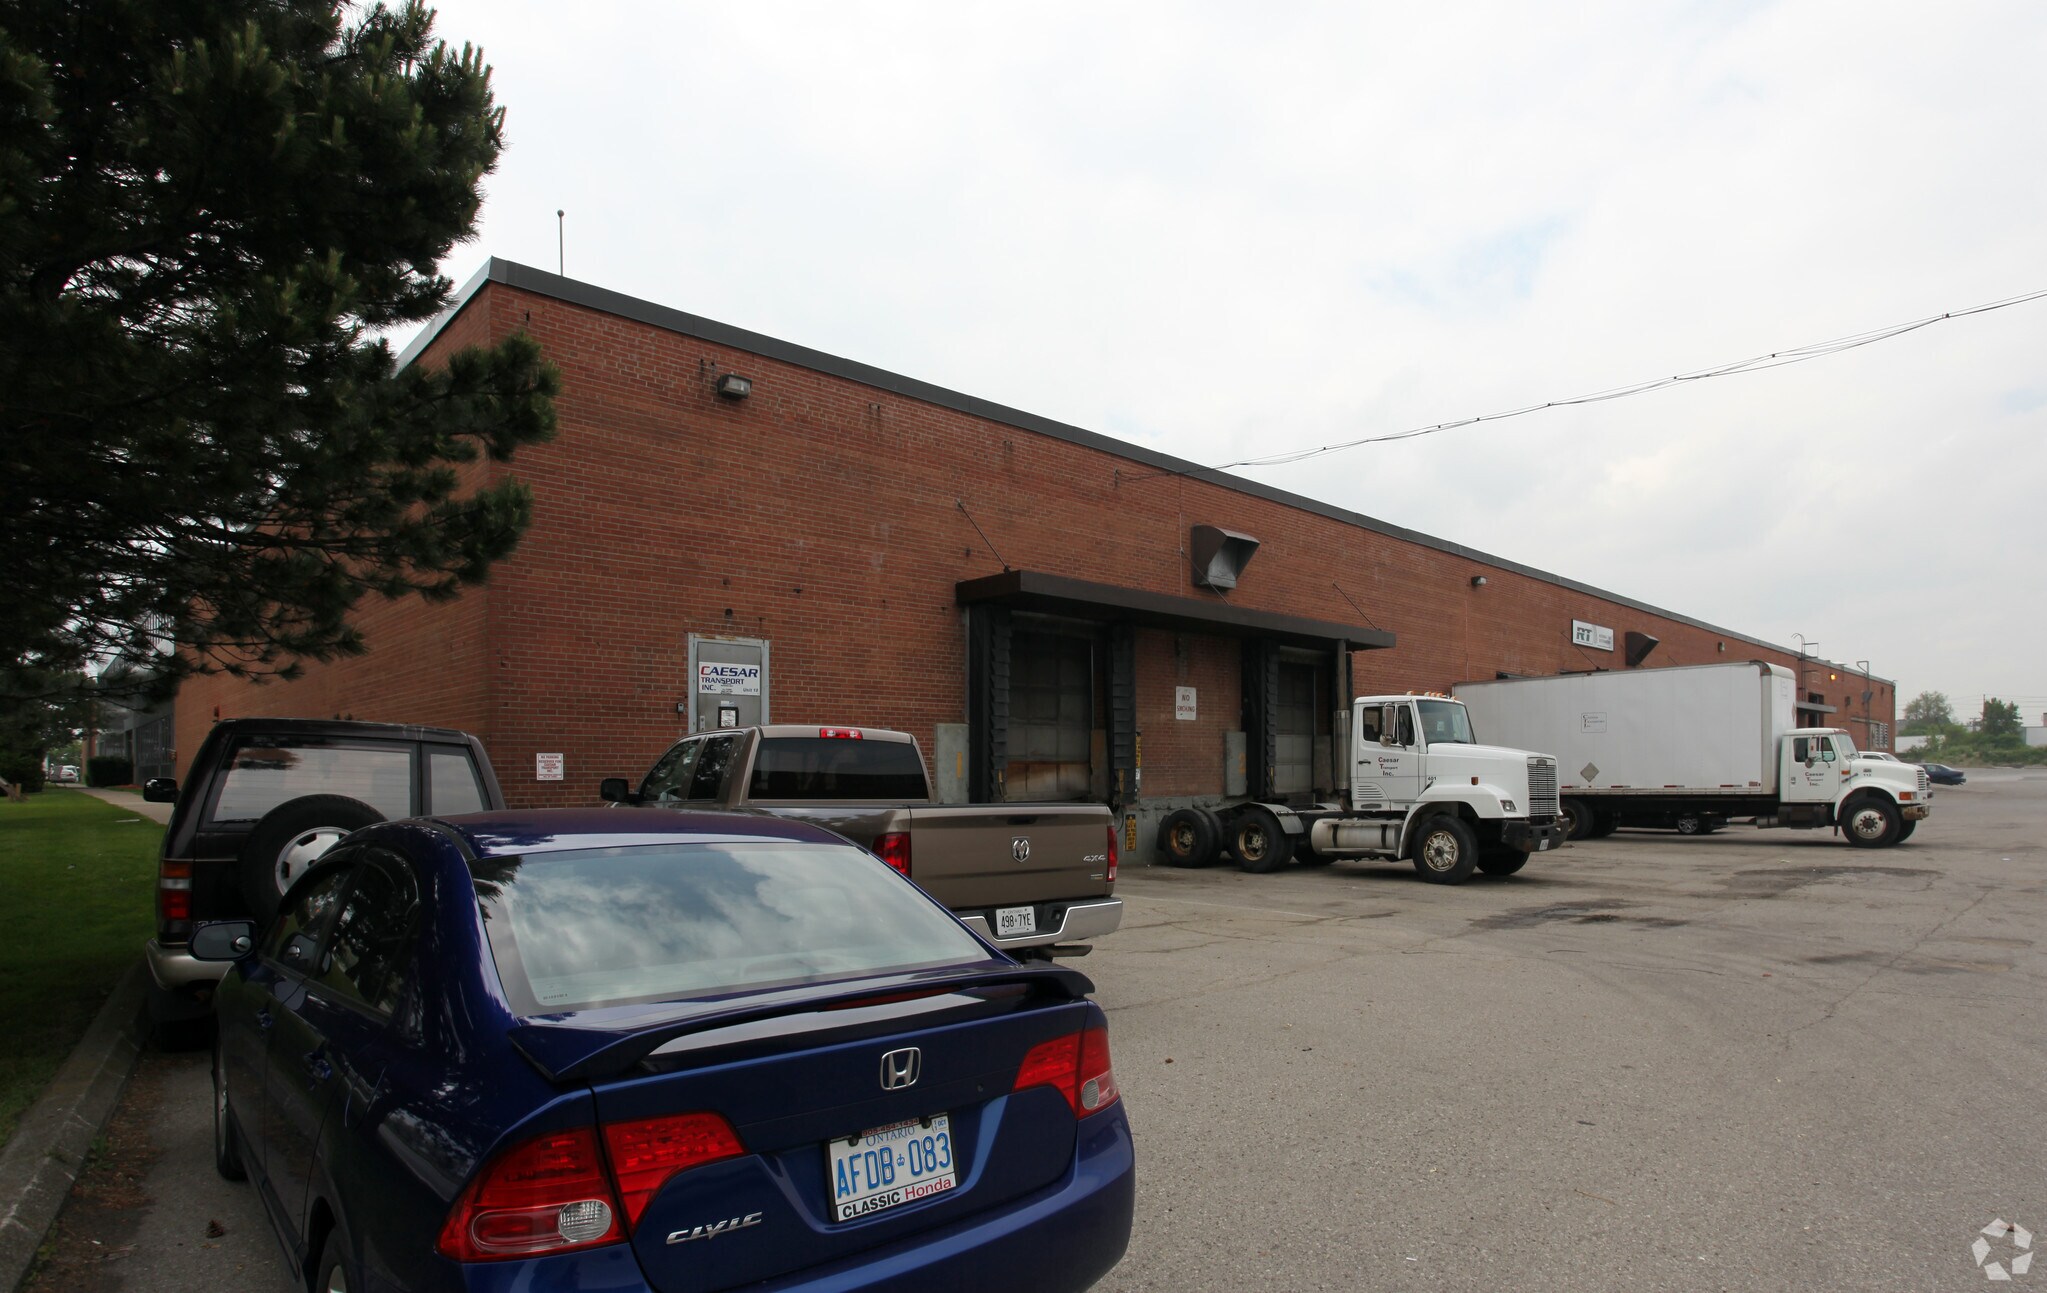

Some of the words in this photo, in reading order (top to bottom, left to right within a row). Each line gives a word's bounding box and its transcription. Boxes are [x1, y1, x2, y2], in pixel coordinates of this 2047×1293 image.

[1576, 626, 1592, 642] RT
[701, 666, 758, 678] CAESAR
[701, 677, 744, 685] TRANSPORT
[1001, 914, 1015, 928] 498
[1018, 912, 1031, 926] 7YE
[866, 1126, 915, 1147] ONTARIO
[837, 1146, 896, 1199] AFDB
[908, 1132, 952, 1177] 083
[905, 1177, 953, 1201] Honda
[842, 1191, 901, 1219] CLASSIC
[666, 1212, 763, 1245] CIVIC
